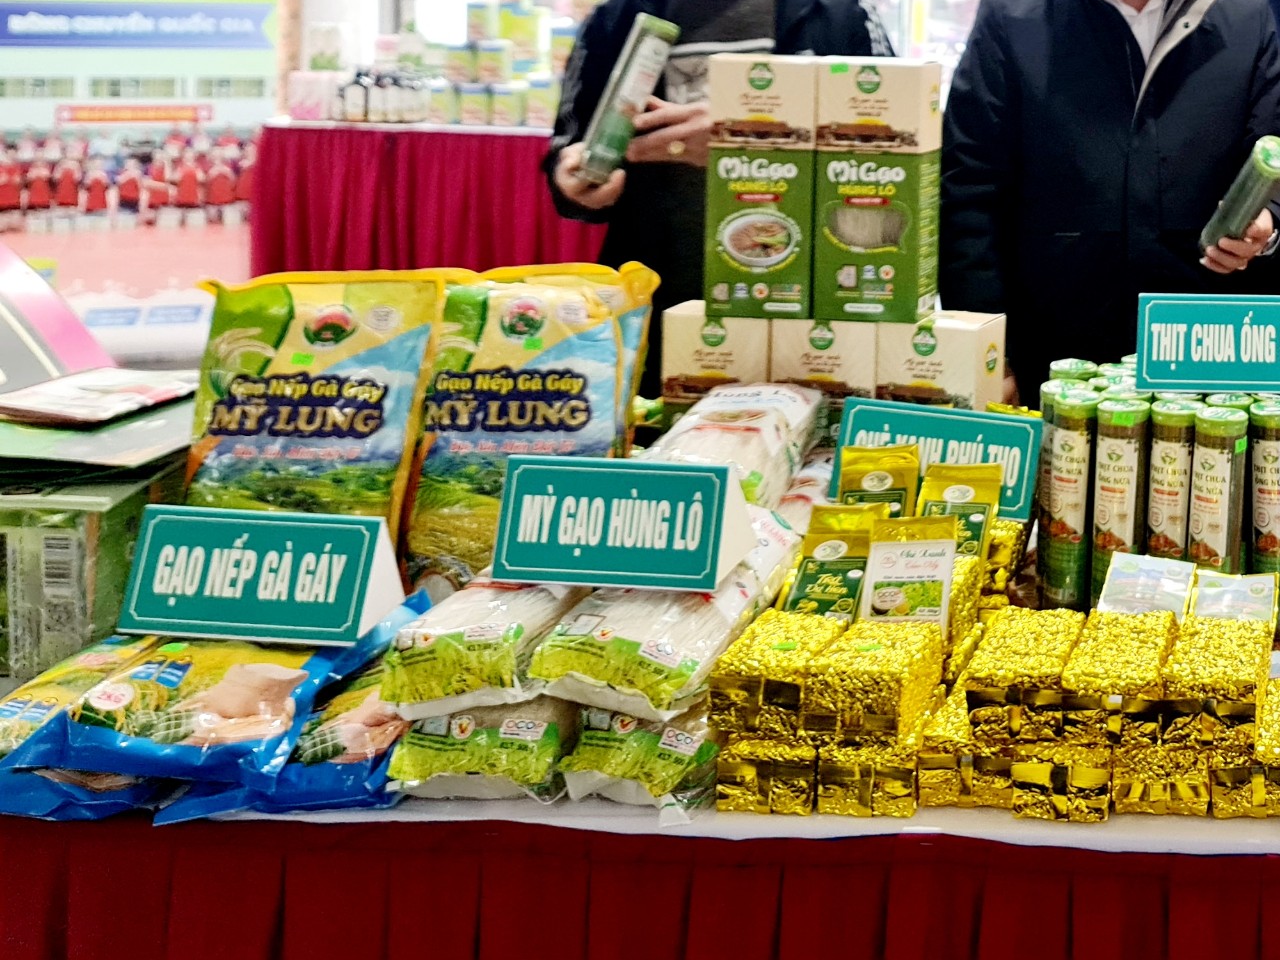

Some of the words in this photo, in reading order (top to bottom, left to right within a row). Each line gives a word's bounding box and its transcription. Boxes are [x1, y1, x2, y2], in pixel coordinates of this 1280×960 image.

[1151, 323, 1187, 371] THỊT
[1190, 323, 1236, 363] CHUA
[1240, 310, 1276, 363] ỐNG
[311, 378, 339, 397] Gà
[475, 370, 515, 395] Nếp
[517, 372, 543, 391] Gà
[545, 371, 584, 395] Gáy
[212, 398, 268, 431] MỸ
[272, 404, 381, 434] LUNG
[425, 393, 478, 426] MỸ
[485, 398, 589, 427] LUNG
[517, 484, 557, 543] MỲ
[557, 495, 605, 557] GẠO
[606, 488, 671, 549] HÙNG
[672, 491, 704, 551] LÔ
[152, 544, 206, 607] GẠO
[203, 533, 258, 599] NẾP
[257, 541, 293, 601] GÀ
[294, 543, 348, 603] GÁY
[666, 728, 696, 745] OCO
